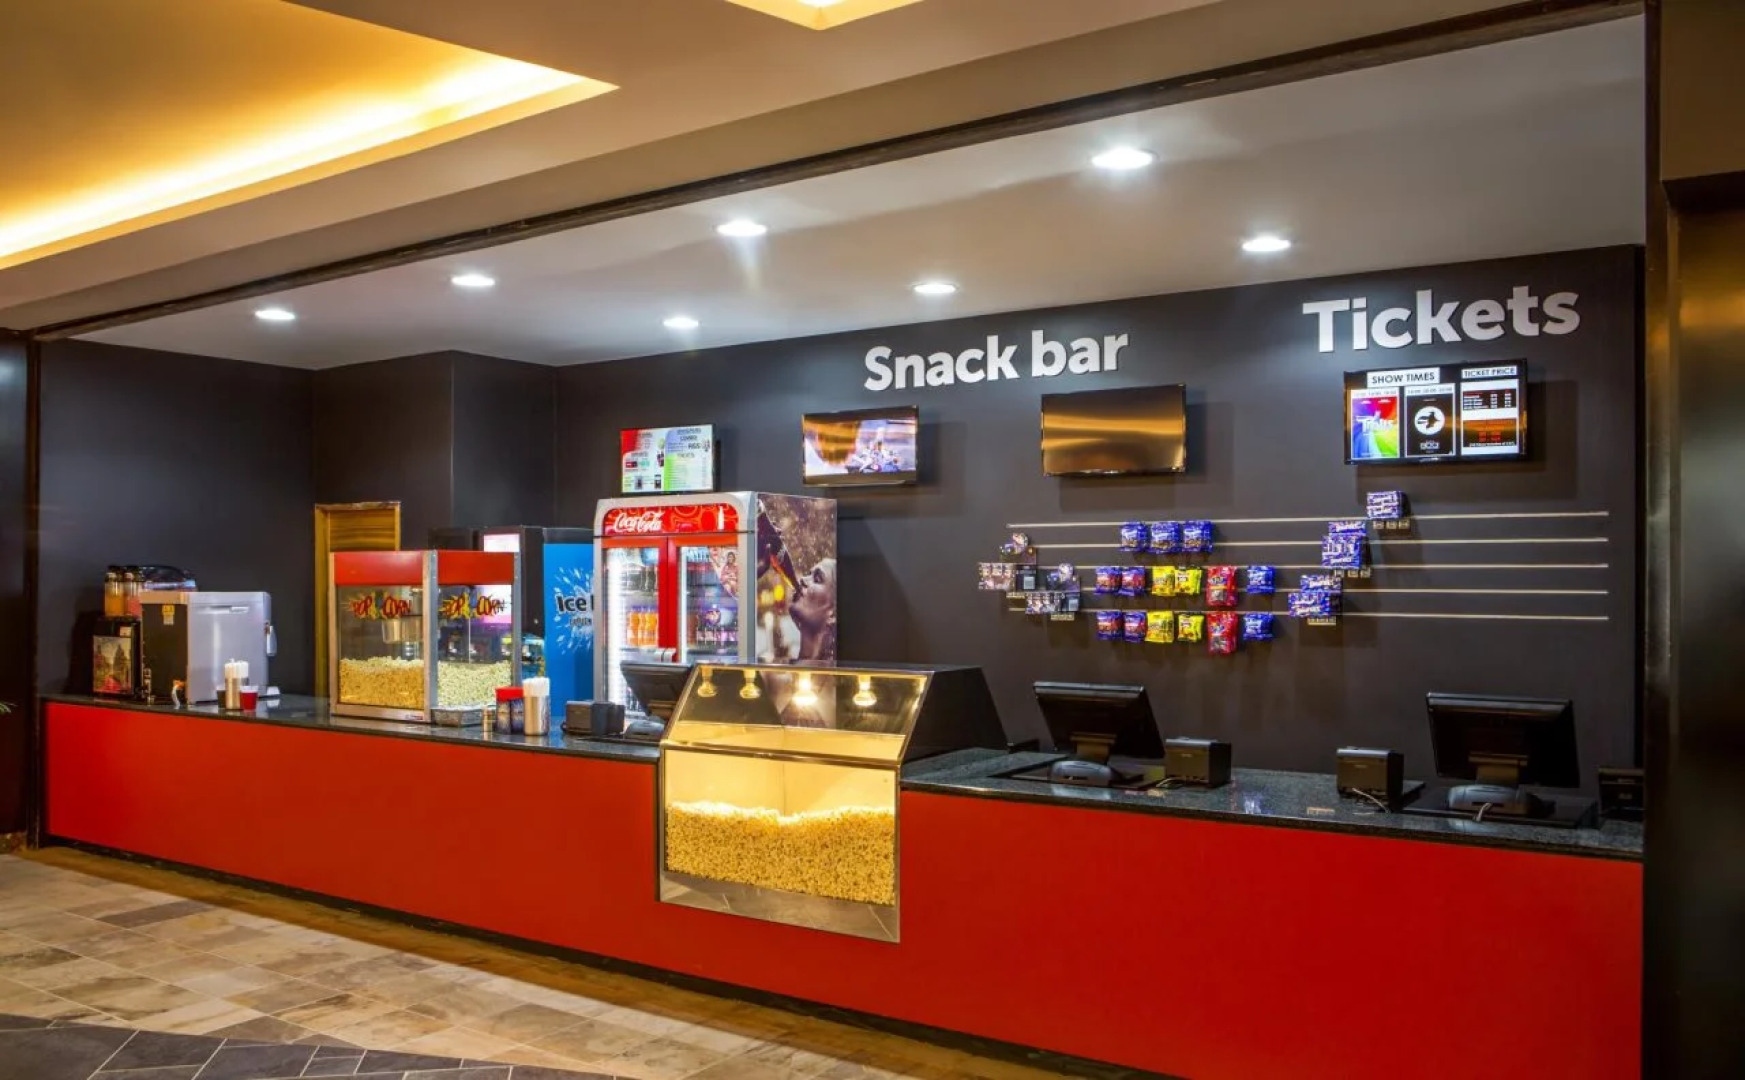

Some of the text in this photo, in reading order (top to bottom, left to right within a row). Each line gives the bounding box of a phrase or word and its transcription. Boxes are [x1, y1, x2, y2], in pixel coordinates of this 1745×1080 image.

[1302, 285, 1581, 353] Tickets
[864, 330, 1129, 391] Snack bar
[1372, 372, 1435, 384] SHOW TIMES
[1464, 368, 1515, 377] TICKET PRICE
[555, 594, 587, 613] Ice
